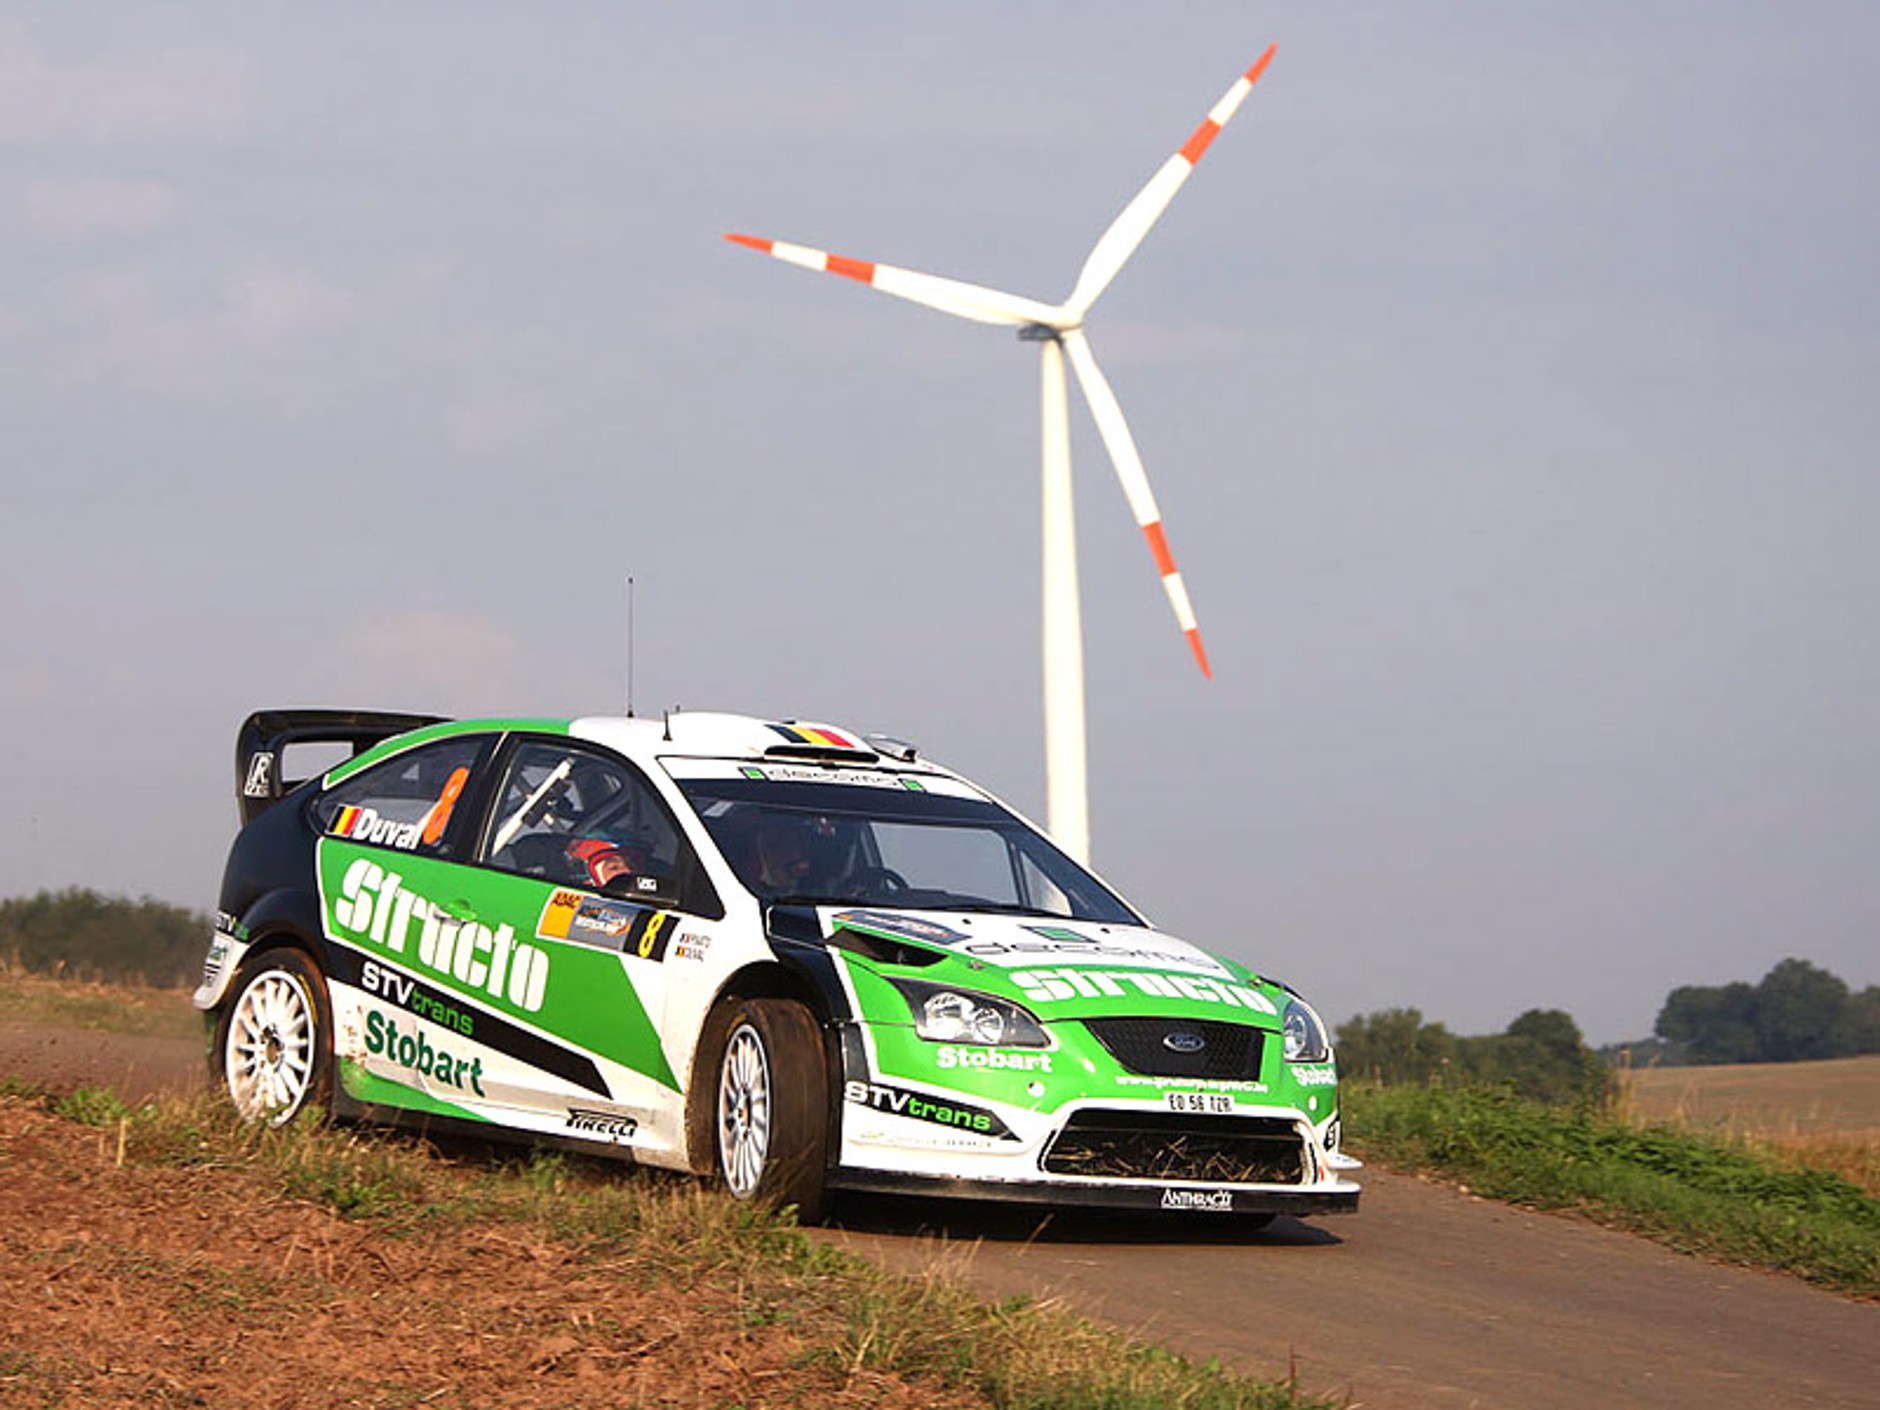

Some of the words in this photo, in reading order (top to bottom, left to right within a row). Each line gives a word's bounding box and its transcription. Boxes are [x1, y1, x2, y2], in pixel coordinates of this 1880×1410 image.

[352, 808, 424, 851] Duval
[423, 766, 470, 845] 8
[336, 858, 550, 1013] Structo
[638, 911, 666, 958] 8
[1008, 968, 1278, 1017] Structo
[364, 1009, 486, 1099] Stobart
[936, 1046, 1053, 1073] Stobart
[565, 1107, 639, 1138] PIRELLI
